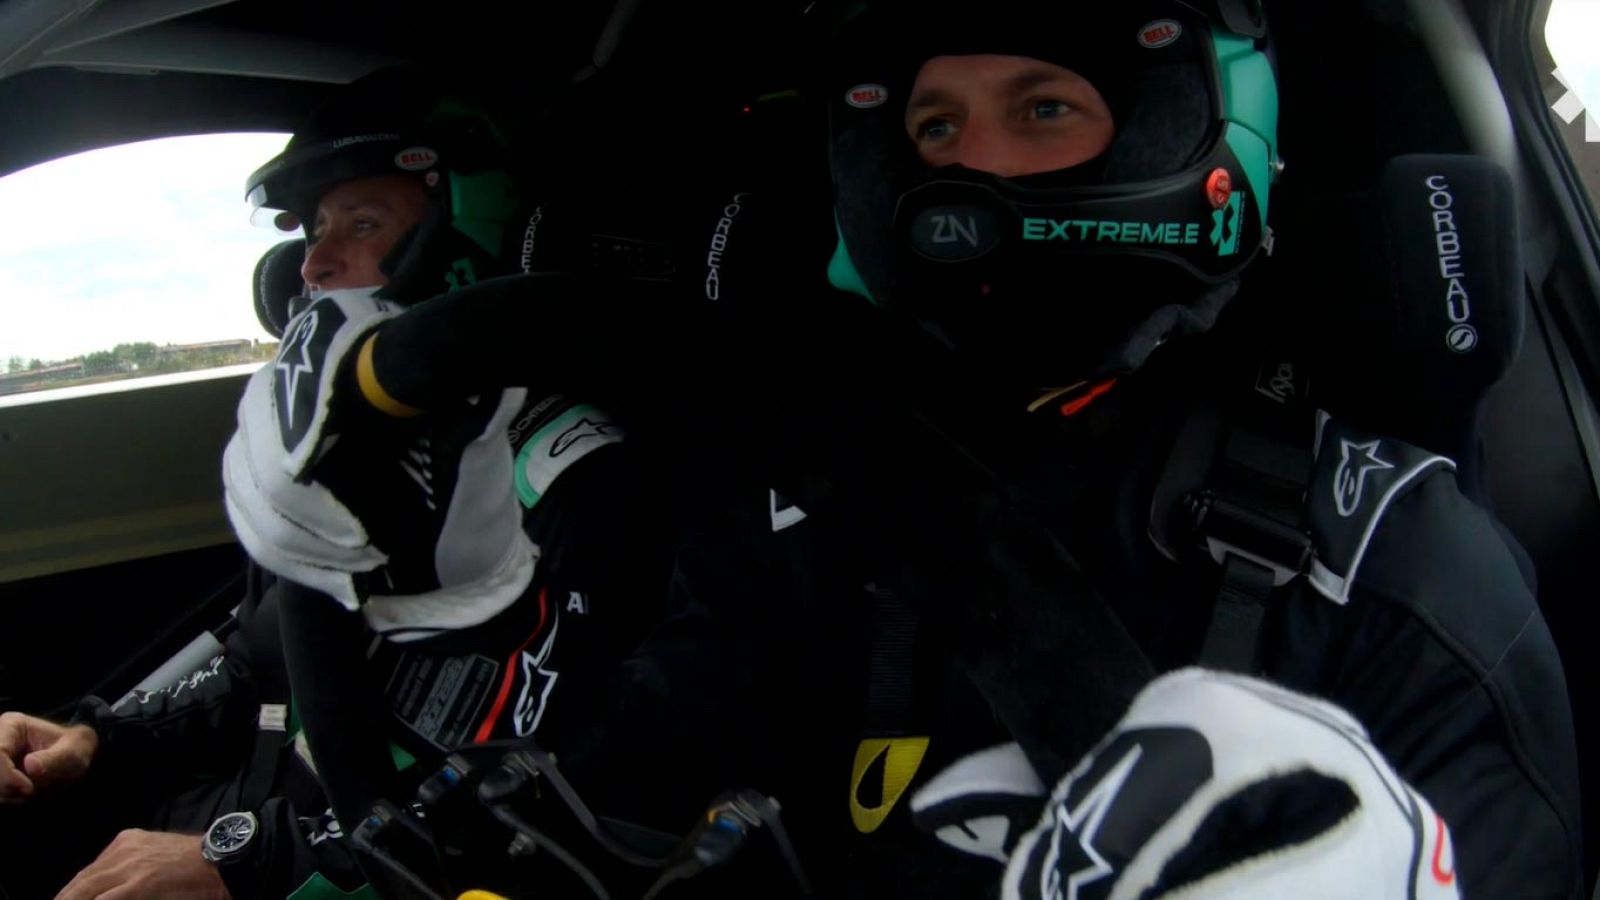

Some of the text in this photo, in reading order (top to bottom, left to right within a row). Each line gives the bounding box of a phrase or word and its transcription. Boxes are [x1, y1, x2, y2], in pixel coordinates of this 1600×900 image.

[401, 152, 433, 164] BELL
[705, 191, 751, 301] CORBEAU
[930, 213, 977, 248] ZN
[1425, 175, 1471, 324] CORBEAU
